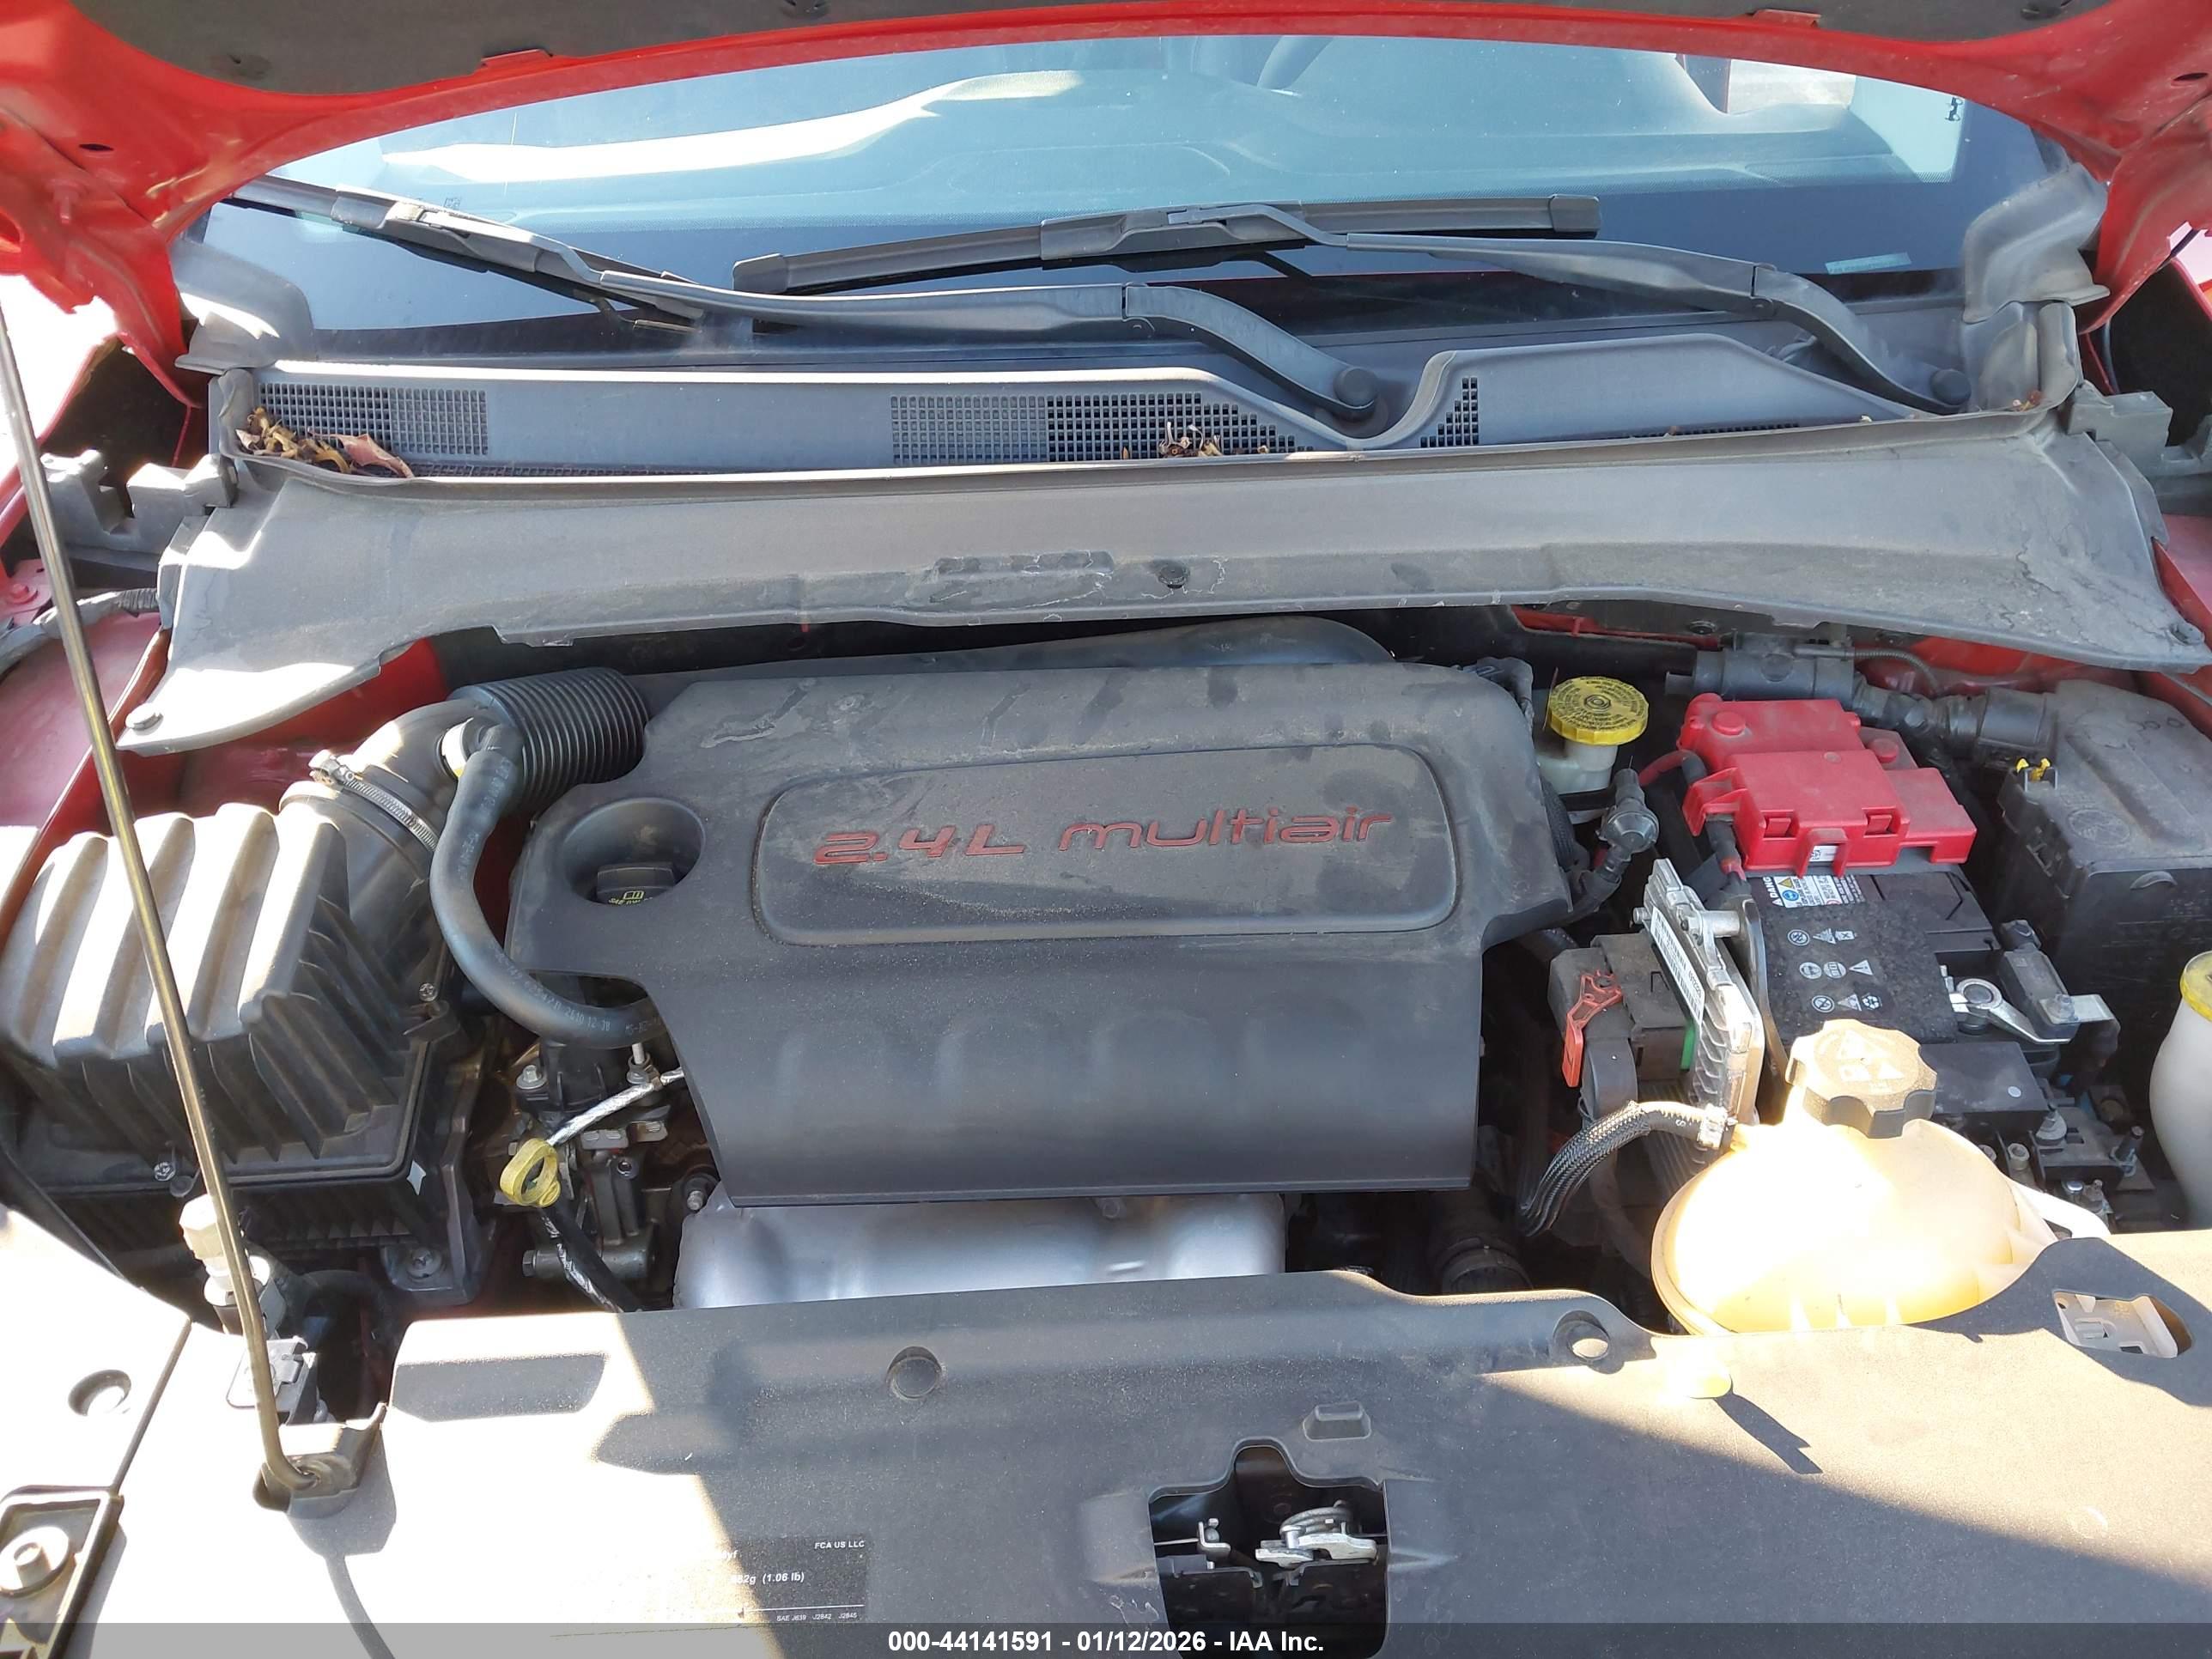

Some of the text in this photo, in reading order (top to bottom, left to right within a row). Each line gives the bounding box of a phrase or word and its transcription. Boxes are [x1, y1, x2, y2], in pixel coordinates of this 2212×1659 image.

[812, 807, 1395, 865] 2.4L multiair
[1763, 876, 1779, 898] DANG
[763, 1572, 788, 1584] (1.06
[791, 1571, 805, 1583] lb)
